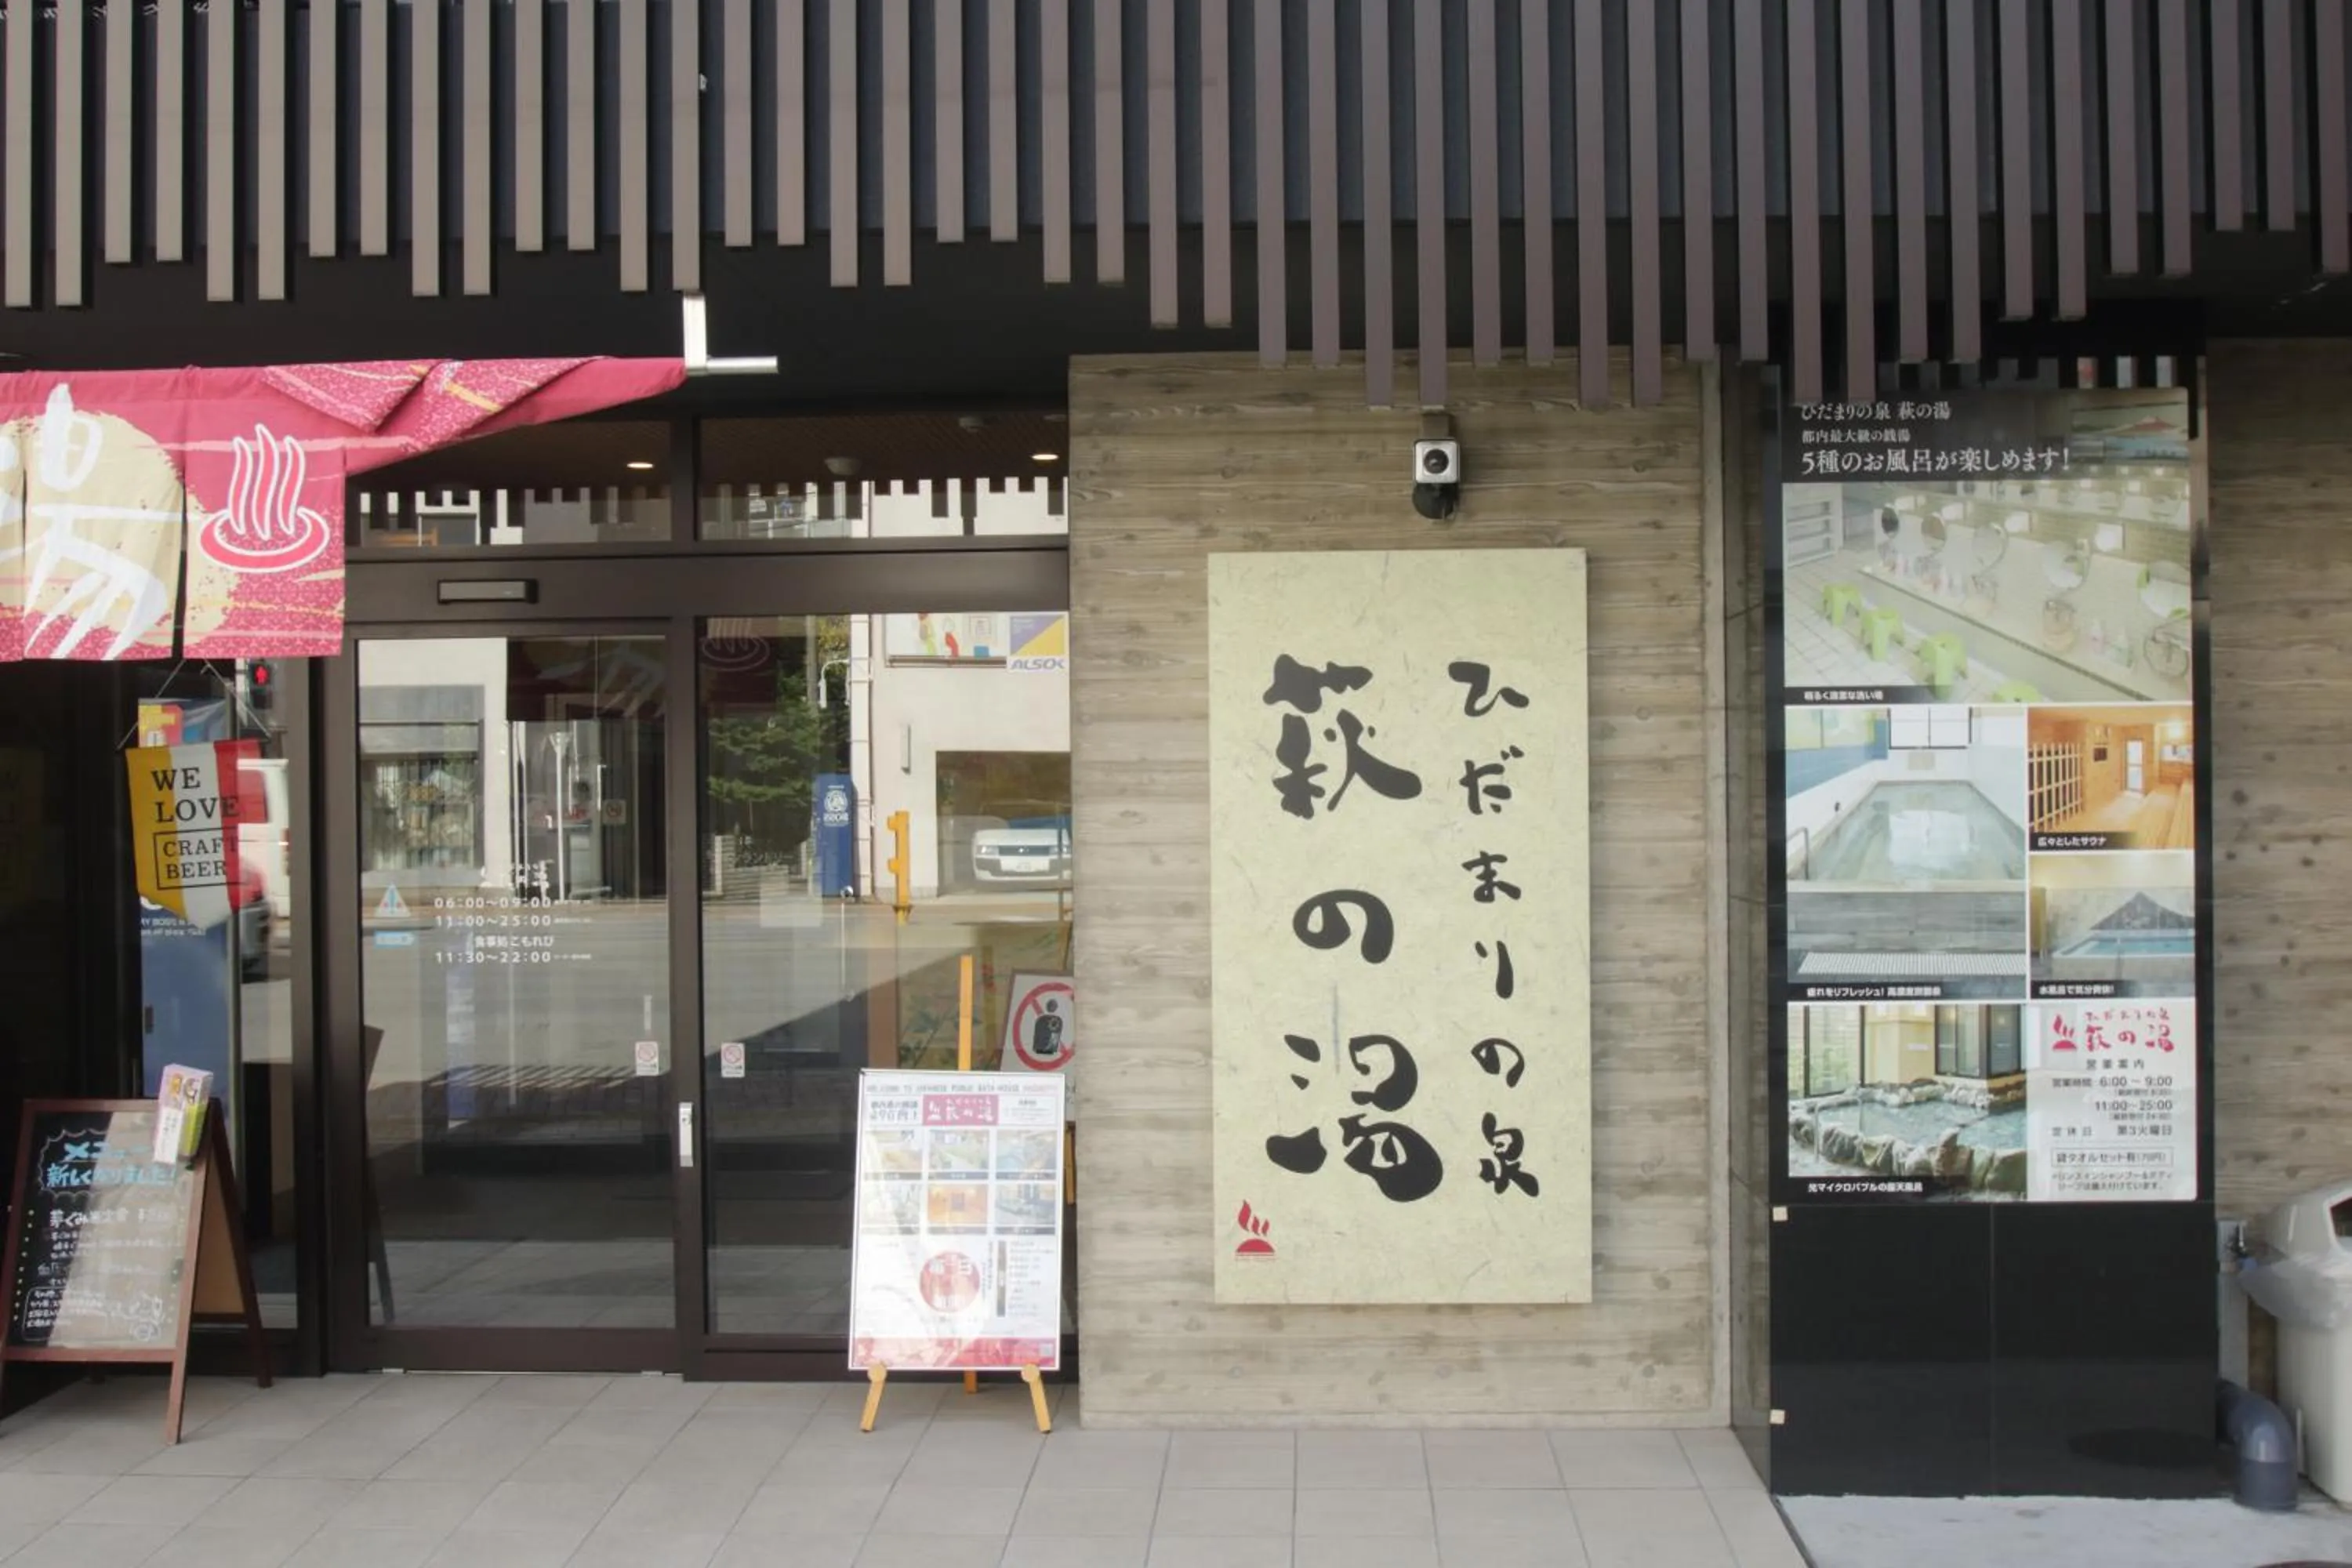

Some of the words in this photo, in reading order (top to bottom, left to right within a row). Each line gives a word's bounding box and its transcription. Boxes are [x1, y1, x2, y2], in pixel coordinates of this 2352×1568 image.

[1802, 401, 1890, 420] ひだまりの泉
[1898, 401, 1952, 420] 萩の湯
[1802, 447, 2071, 474] 5種のお風呂が楽しめます!
[1011, 658, 1065, 670] ALSOK
[151, 766, 201, 791] WE
[154, 796, 241, 823] LOVE
[162, 836, 236, 858] CRAFT
[166, 860, 227, 880] BEER
[1262, 652, 1444, 1203] 萩の湯
[1448, 660, 1540, 1199] ひだまりの泉
[2085, 1024, 2175, 1052] 萩の湯
